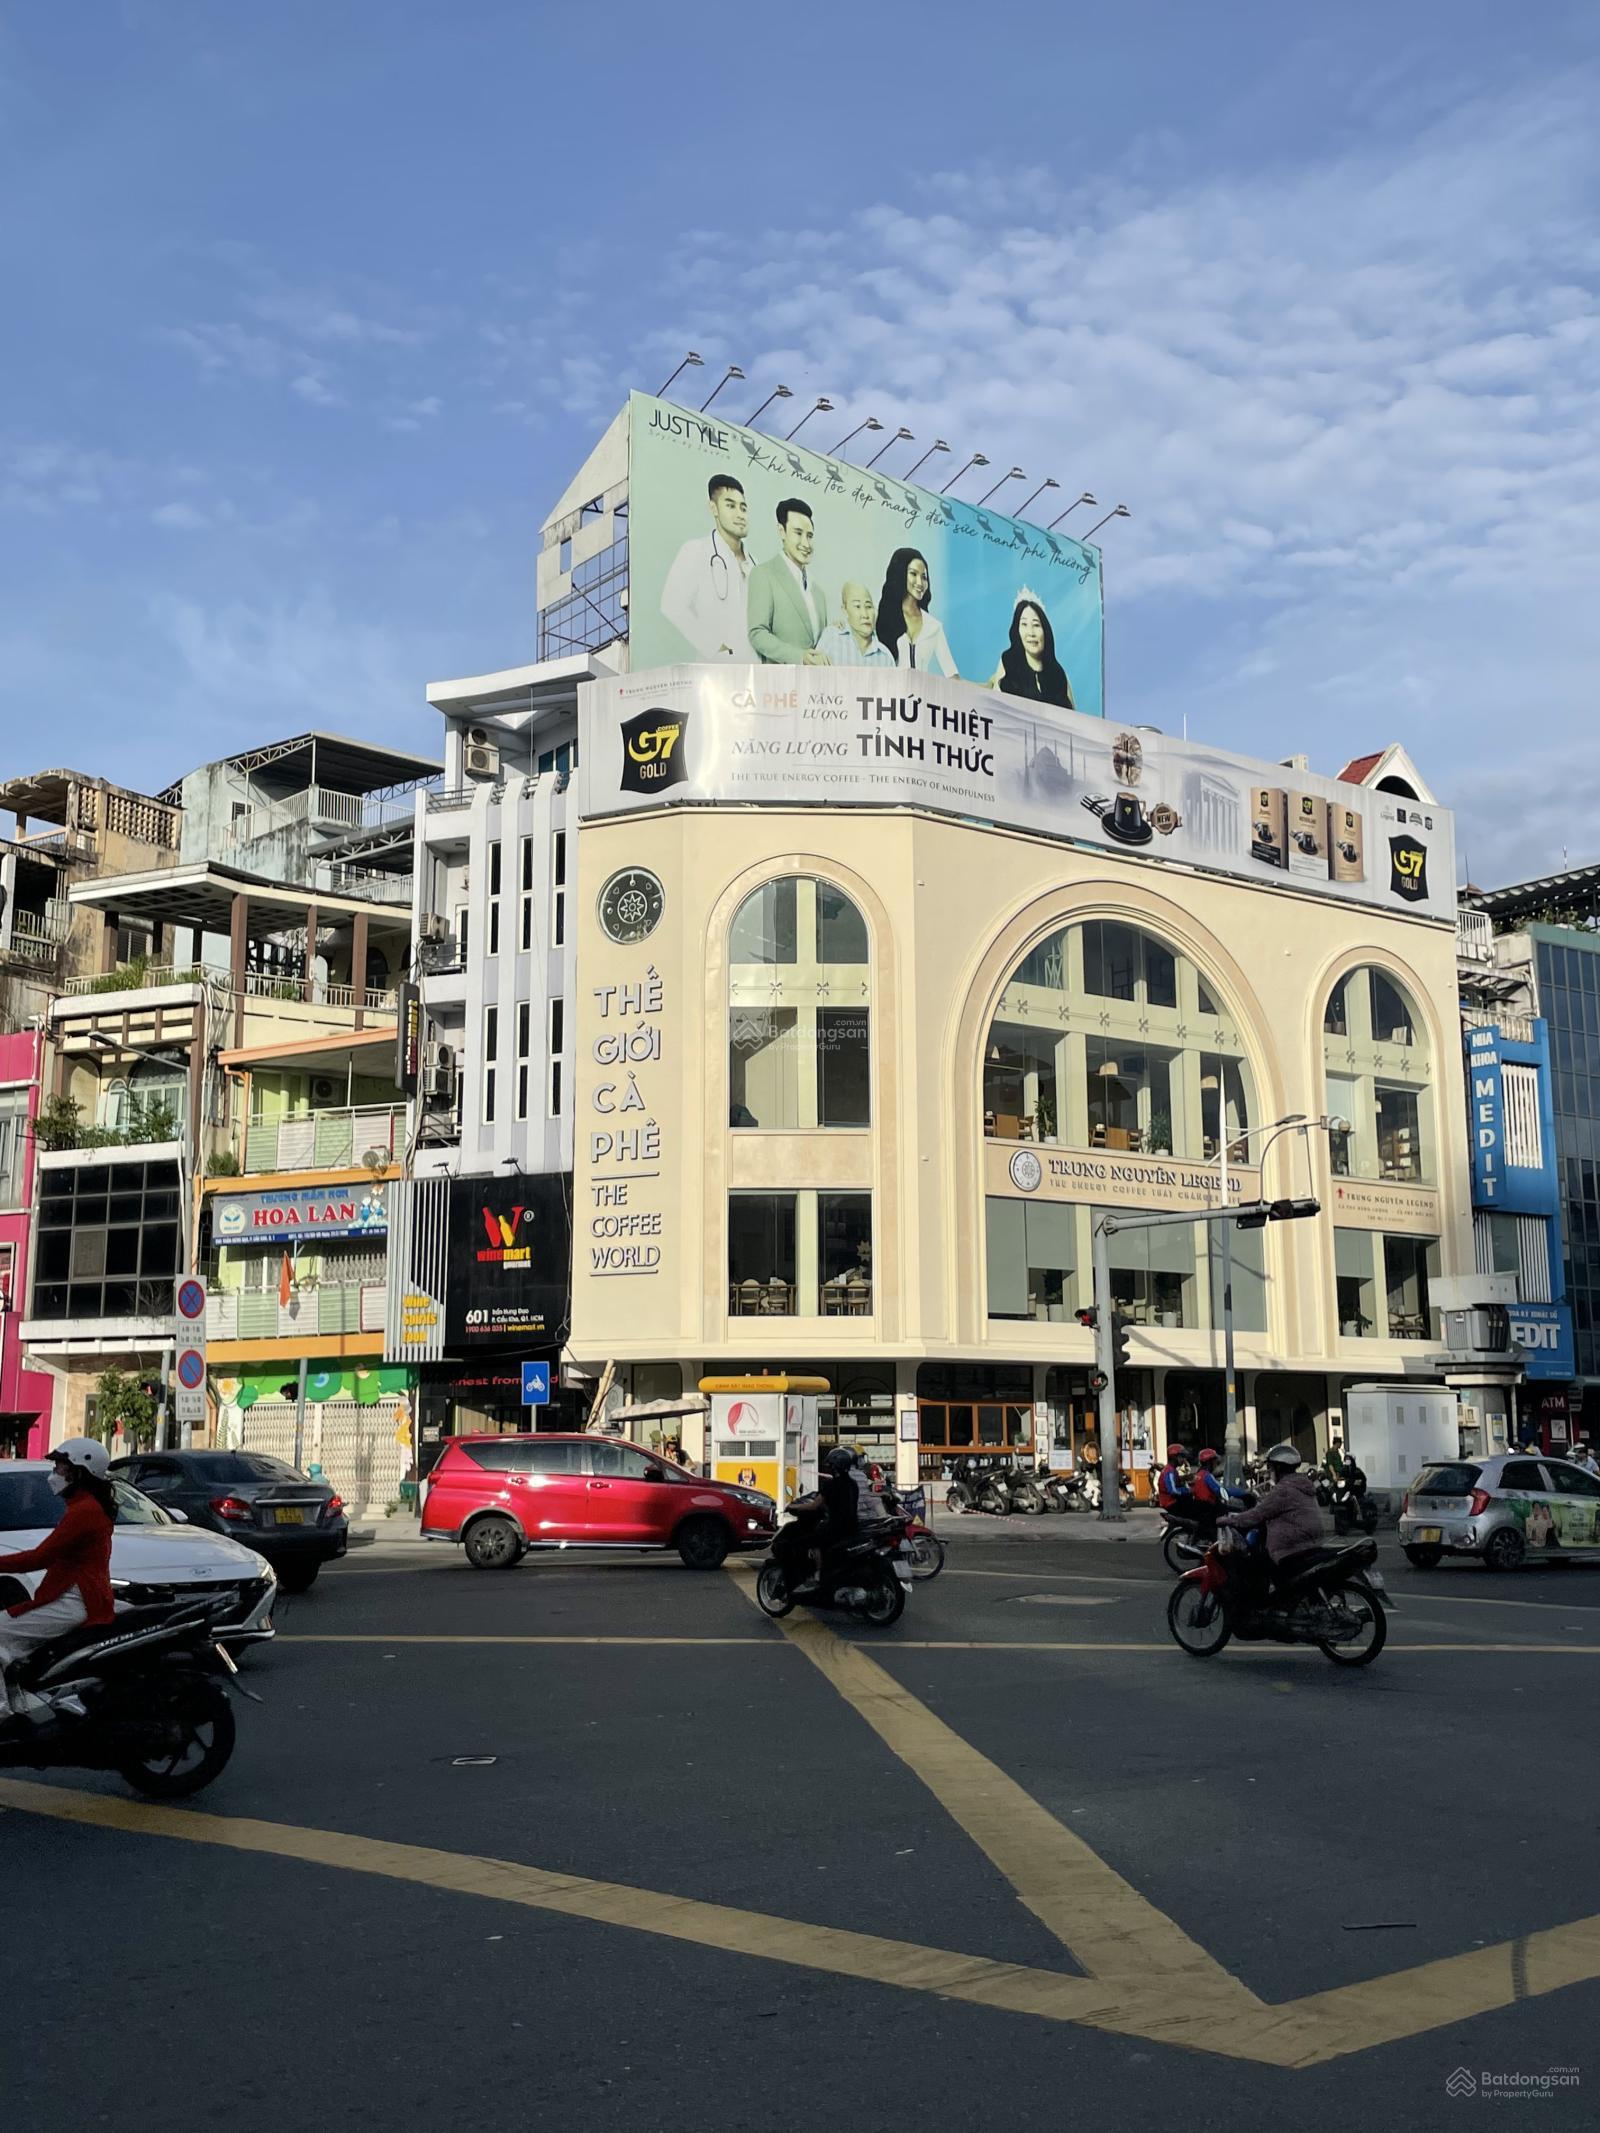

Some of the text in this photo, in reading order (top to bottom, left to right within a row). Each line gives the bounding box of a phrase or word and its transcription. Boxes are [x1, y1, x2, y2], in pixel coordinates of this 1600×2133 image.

[649, 409, 729, 451] JUSTYLE
[748, 446, 786, 472] Khi
[881, 499, 921, 529] mang
[731, 688, 798, 708] CÀ PHÊ
[807, 693, 844, 706] NĂNG
[803, 708, 849, 721] LƯỢNG
[856, 693, 994, 742] THỨ THIỆT
[628, 730, 680, 762] G7
[731, 739, 849, 759] NĂNG LƯỢNG
[856, 726, 994, 777] TỈNH THỨC
[640, 762, 667, 779] GOLD
[731, 772, 996, 803] THE TRUE ENERGY COFFEE THE ENERGY OF MINDFULNESS
[1393, 850, 1424, 877] G7
[1401, 876, 1418, 891] GOLD
[593, 965, 663, 1017] THẾ
[592, 1020, 661, 1065] GIỚI
[592, 1071, 646, 1114] CÀ
[591, 1118, 661, 1163] PHÊ
[1475, 1077, 1497, 1198] MEDIT
[1048, 1159, 1106, 1179] TRUNG
[1110, 1164, 1176, 1186] NGUYÊN
[591, 1184, 628, 1206] THE
[1347, 1193, 1372, 1202] TRUNG
[252, 1201, 356, 1228] HOA LAN
[590, 1212, 662, 1238] COFFEE
[590, 1245, 661, 1269] WORLD
[466, 1309, 489, 1324] 601
[1510, 1322, 1561, 1349] EDIT
[1541, 1396, 1565, 1409] ATM
